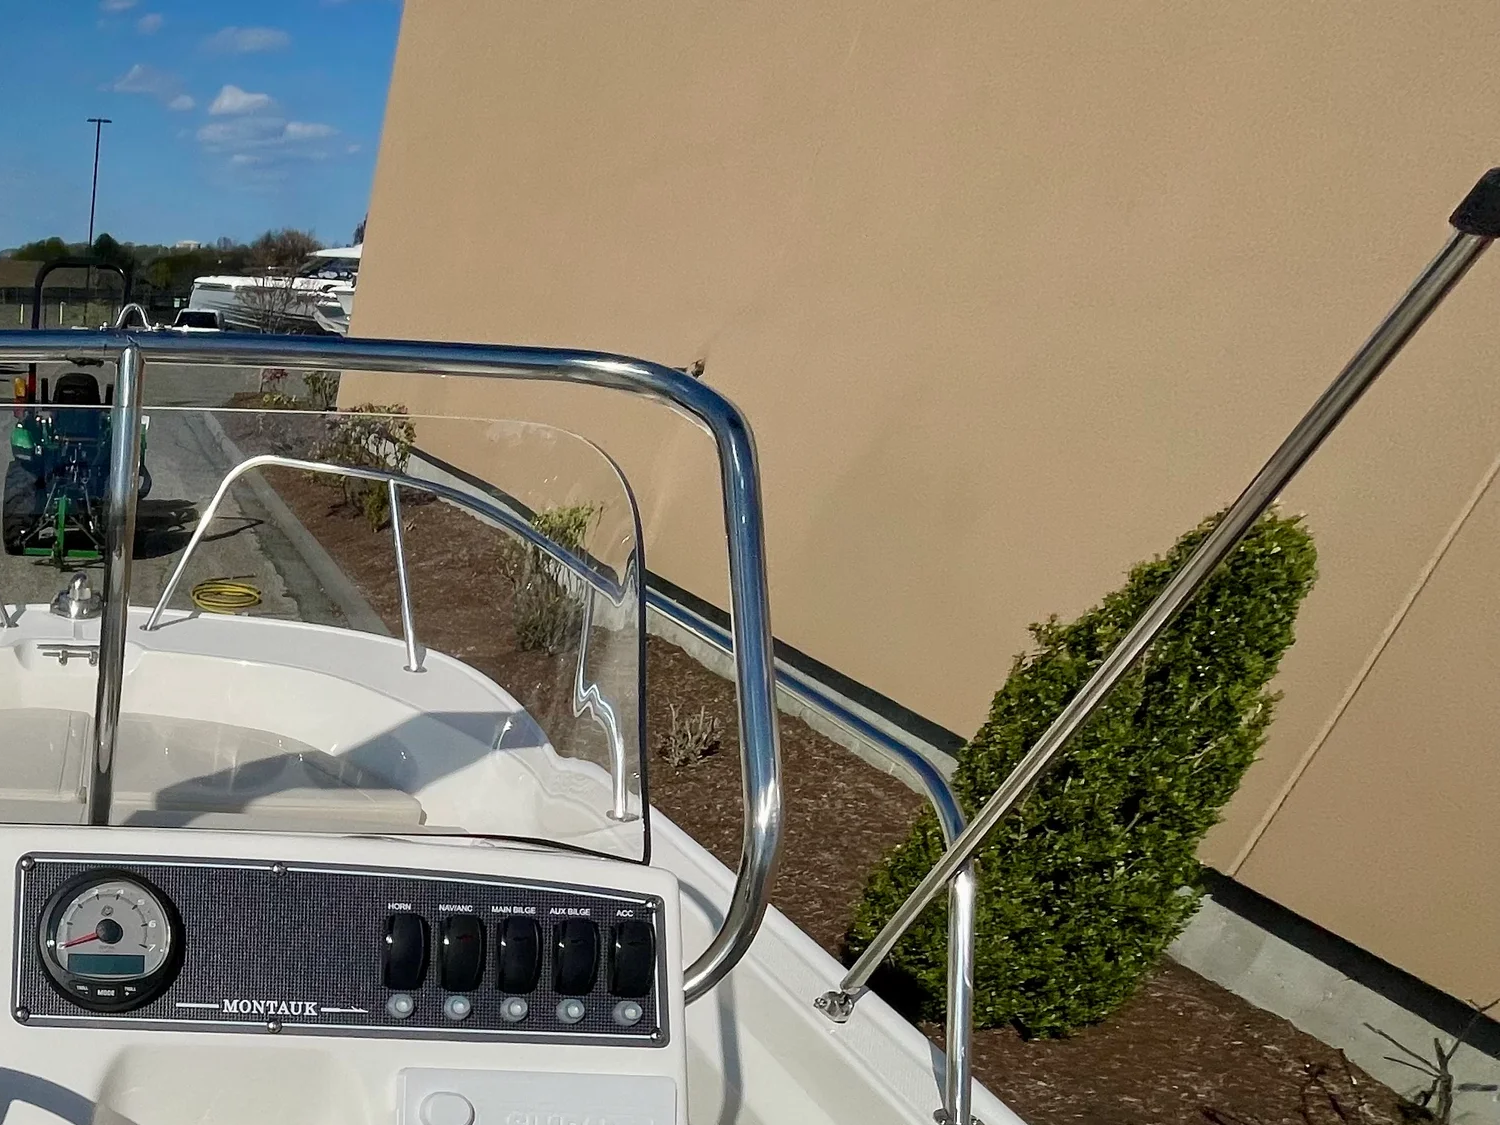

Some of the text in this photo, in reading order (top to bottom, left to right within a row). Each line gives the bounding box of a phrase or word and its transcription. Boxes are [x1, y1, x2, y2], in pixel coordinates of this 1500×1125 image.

[439, 904, 473, 912] NAV/ANC
[491, 905, 536, 914] MAIN BILGE
[549, 907, 591, 916] AUX BILGE
[148, 920, 156, 928] 6
[148, 944, 156, 952] 7
[222, 999, 318, 1016] MONTAUK
